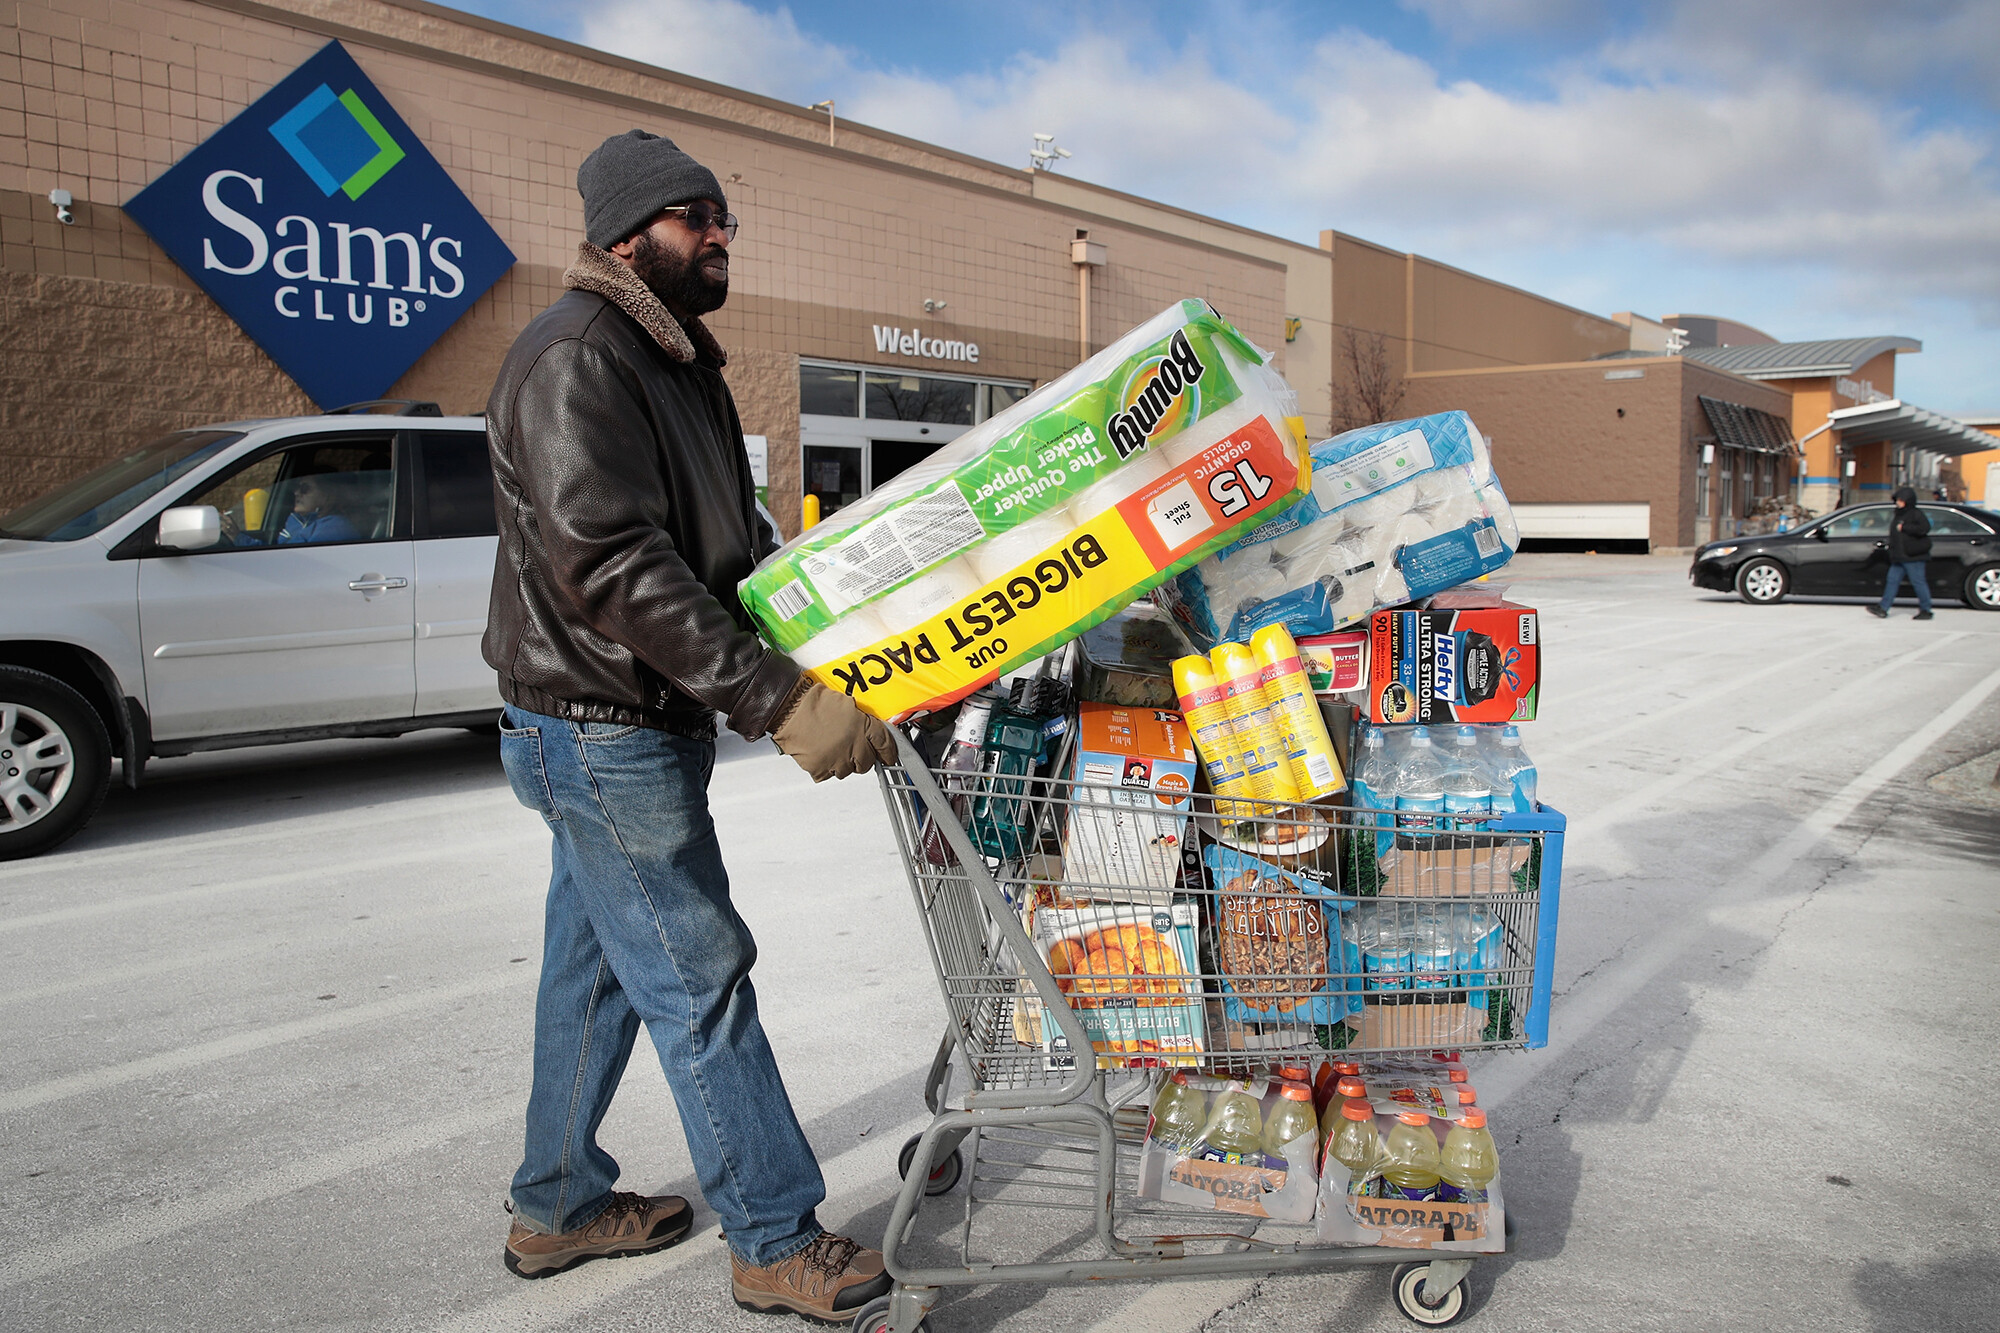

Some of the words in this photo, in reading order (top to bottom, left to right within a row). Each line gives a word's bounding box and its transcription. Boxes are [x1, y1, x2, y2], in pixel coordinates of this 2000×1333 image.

[202, 169, 465, 299] Sam's
[873, 324, 979, 364] Welcome
[1107, 329, 1205, 459] Bounty
[1038, 426, 1096, 468] Picker
[1069, 447, 1107, 473] The
[1203, 440, 1233, 462] ROLLS
[1194, 441, 1252, 480] GIGANTIC
[995, 469, 1066, 516] Quicker
[1208, 459, 1273, 518] 15
[1165, 501, 1191, 520] Sheet
[1173, 512, 1192, 526] Full
[1251, 521, 1278, 535] ULTRA
[1265, 521, 1299, 539] STRONG
[944, 534, 1109, 653] BIGGEST
[1376, 616, 1388, 633] 90
[1421, 616, 1431, 659] ULTRA
[1522, 617, 1530, 643] NEW!
[833, 632, 942, 696] PACK
[965, 637, 1008, 670] OUR
[1479, 649, 1489, 667] TRIPLE
[1266, 669, 1285, 680] CLEAN
[1404, 664, 1412, 676] 33
[1434, 638, 1453, 698] Hefty
[1479, 668, 1489, 688] ACTION
[1235, 683, 1255, 693] CLEAN
[1421, 663, 1431, 718] STRONG
[1042, 720, 1067, 737] almart
[1122, 778, 1149, 787] QUAKER
[1120, 792, 1147, 800] INSANT
[1227, 892, 1308, 913] SHELLE
[1224, 905, 1319, 937] WALNUTS
[1170, 1170, 1261, 1202] ATORA
[1360, 1206, 1477, 1231] ATORADE
